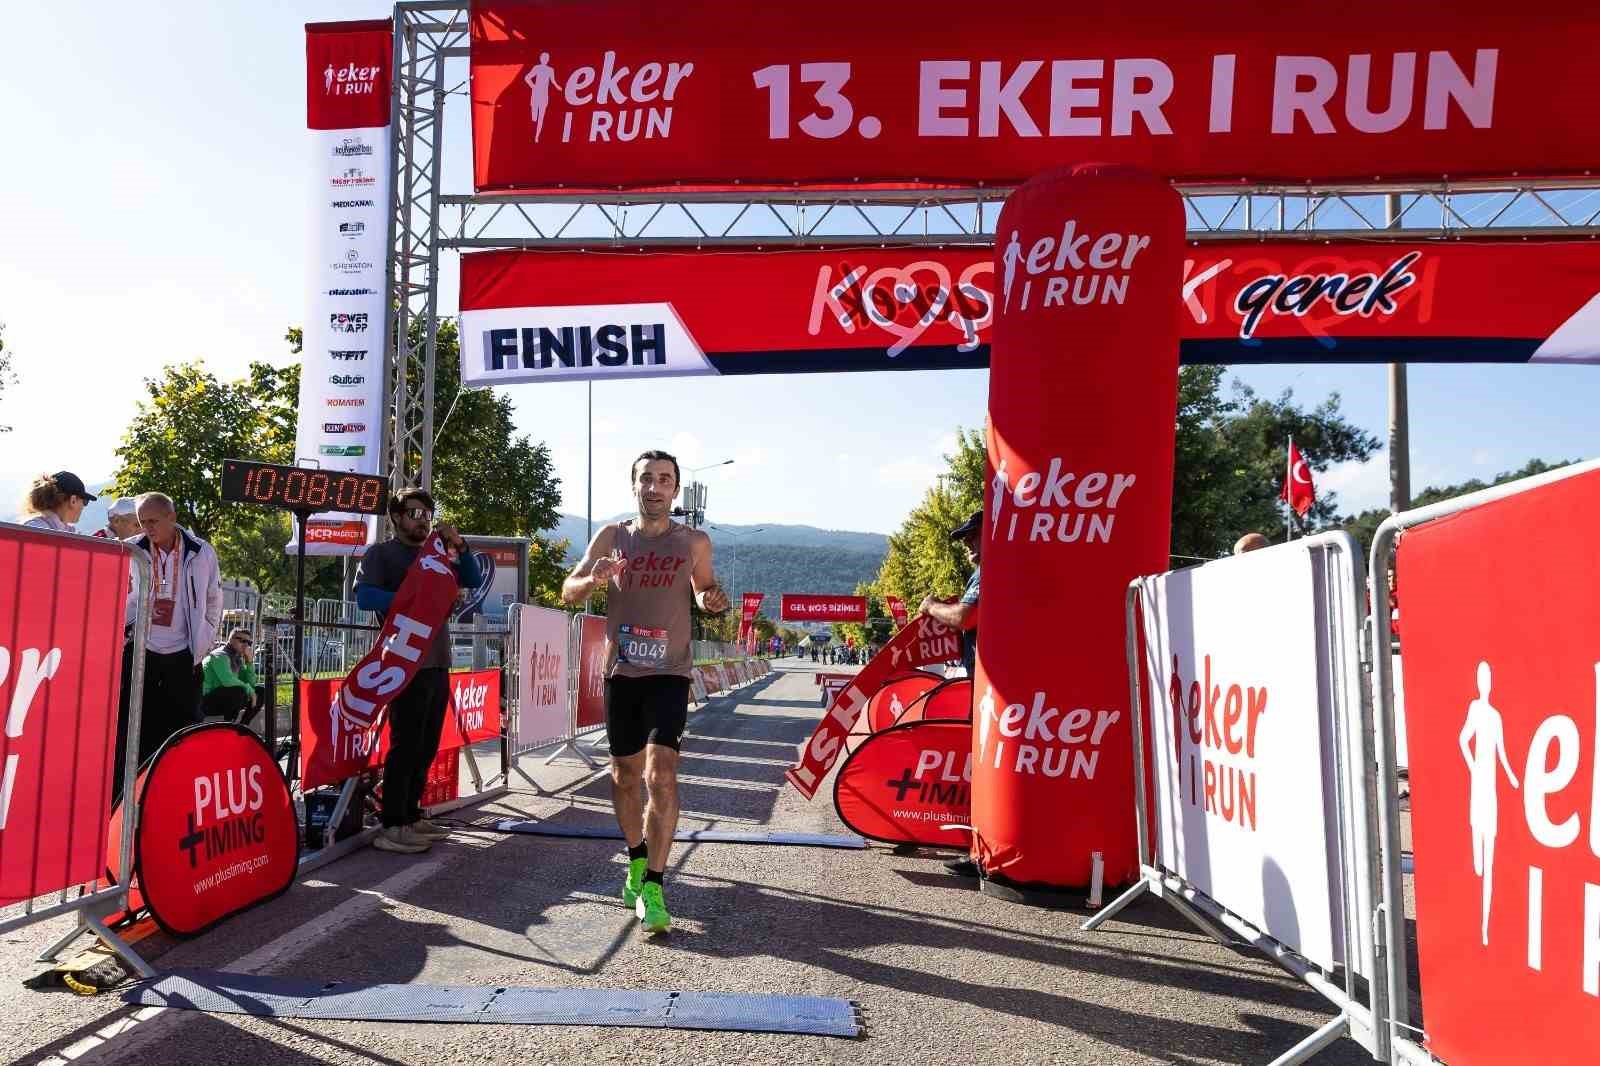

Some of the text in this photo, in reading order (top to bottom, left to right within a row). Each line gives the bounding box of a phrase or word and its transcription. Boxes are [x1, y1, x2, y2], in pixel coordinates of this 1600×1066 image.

[337, 62, 380, 82] eker
[345, 82, 373, 95] RUN
[564, 50, 694, 106] eker
[752, 48, 1499, 140] 13. EKER I RUN
[562, 107, 673, 144] I RUN
[1027, 219, 1151, 275] eker
[1020, 274, 1130, 311] I RUN
[1210, 250, 1422, 340] gerek
[490, 323, 667, 370] FINISH
[244, 467, 382, 512] 10:08:08
[1013, 457, 1137, 509] eker
[1007, 512, 1116, 544] I RUN
[633, 551, 687, 572] eker
[639, 573, 677, 588] RUN
[790, 603, 807, 612] GEL
[462, 678, 488, 710] eker
[1187, 654, 1267, 759] eker
[466, 710, 484, 732] RUN
[999, 691, 1120, 745] eker
[1014, 744, 1099, 780] RUN
[194, 764, 264, 827] PLUS
[1204, 759, 1256, 832] RUN
[193, 854, 269, 895] www.plustiming.com
